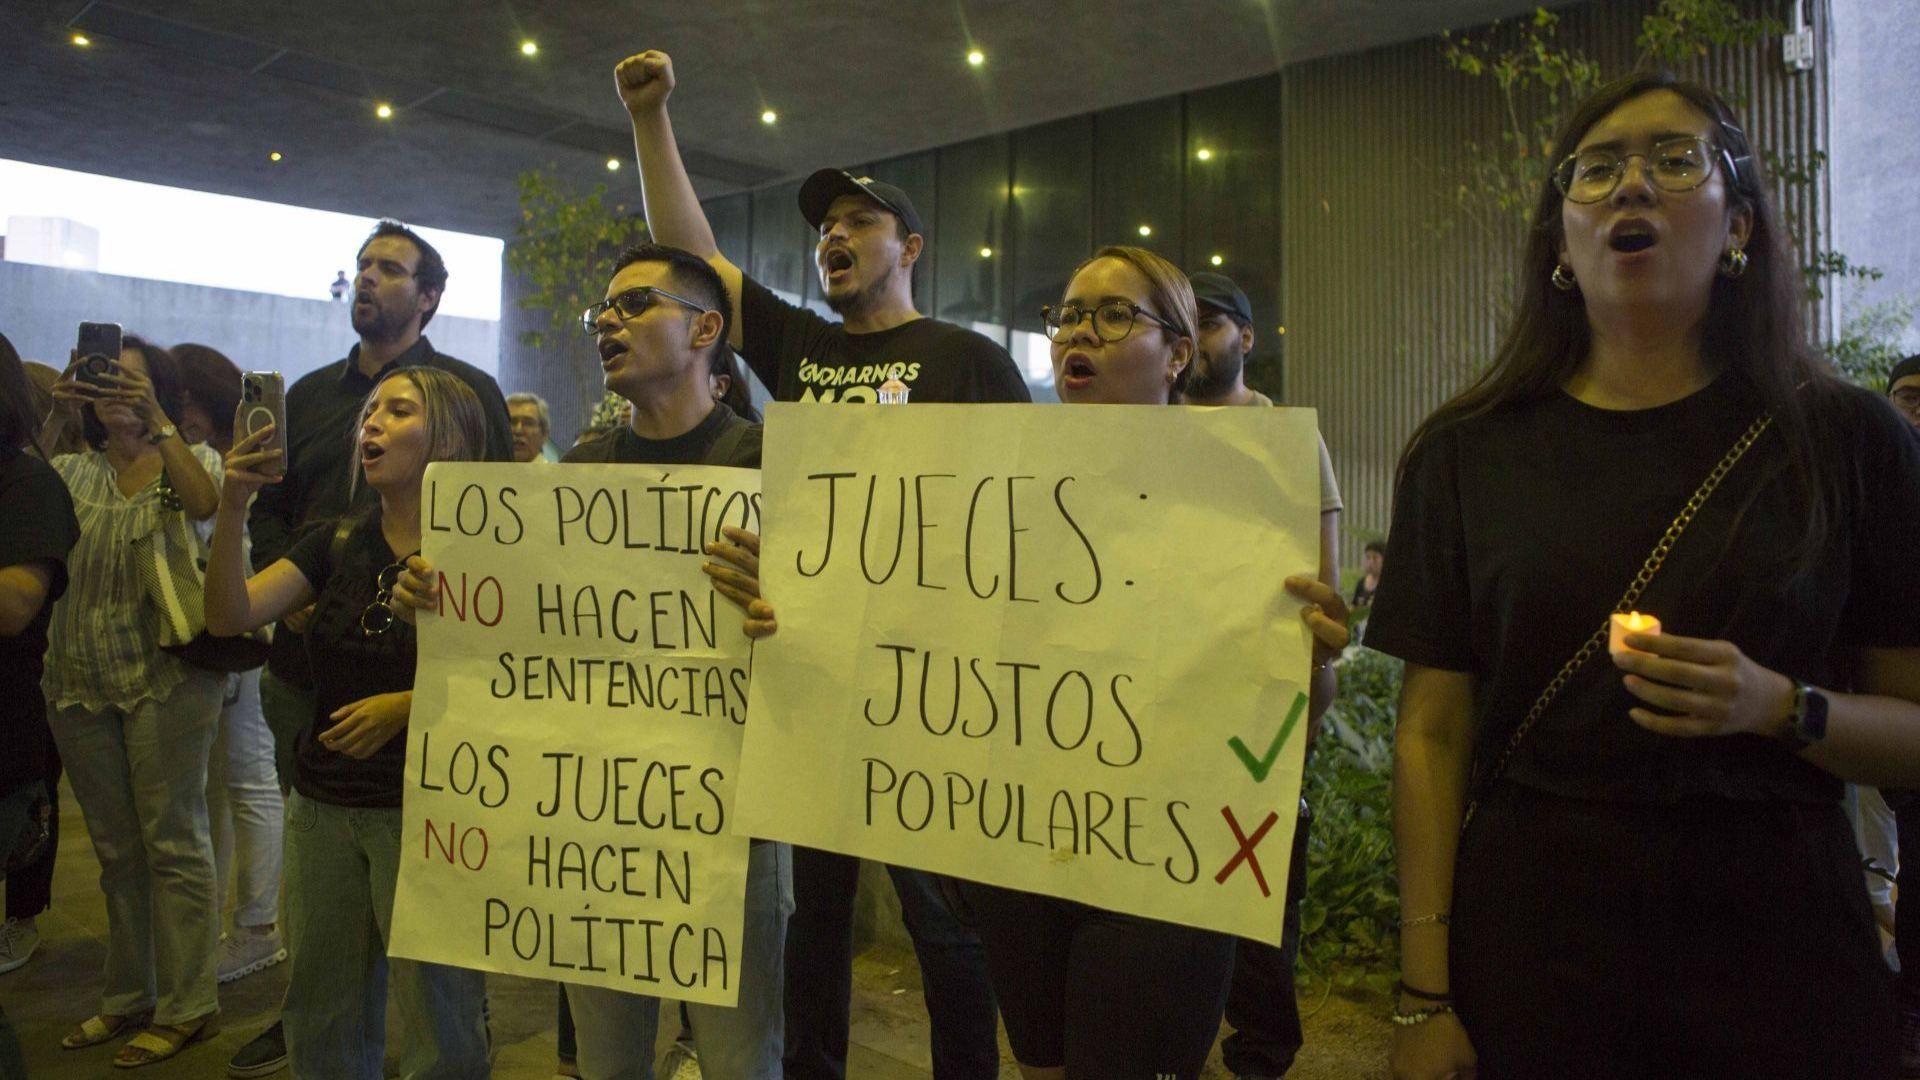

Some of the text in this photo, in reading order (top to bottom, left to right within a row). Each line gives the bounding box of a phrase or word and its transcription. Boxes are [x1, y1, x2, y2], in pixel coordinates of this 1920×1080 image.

[430, 480, 524, 545] LOS
[796, 471, 1148, 605] JUECES:
[437, 570, 716, 650] NO HACEN
[491, 652, 747, 725] SENTENCIAS
[863, 643, 1143, 768] JUSTOS
[420, 732, 725, 836] LOS JUECES
[861, 757, 1200, 884] POPULARES
[425, 818, 691, 905] NO HACEN
[485, 898, 728, 990] POLÍTICA
